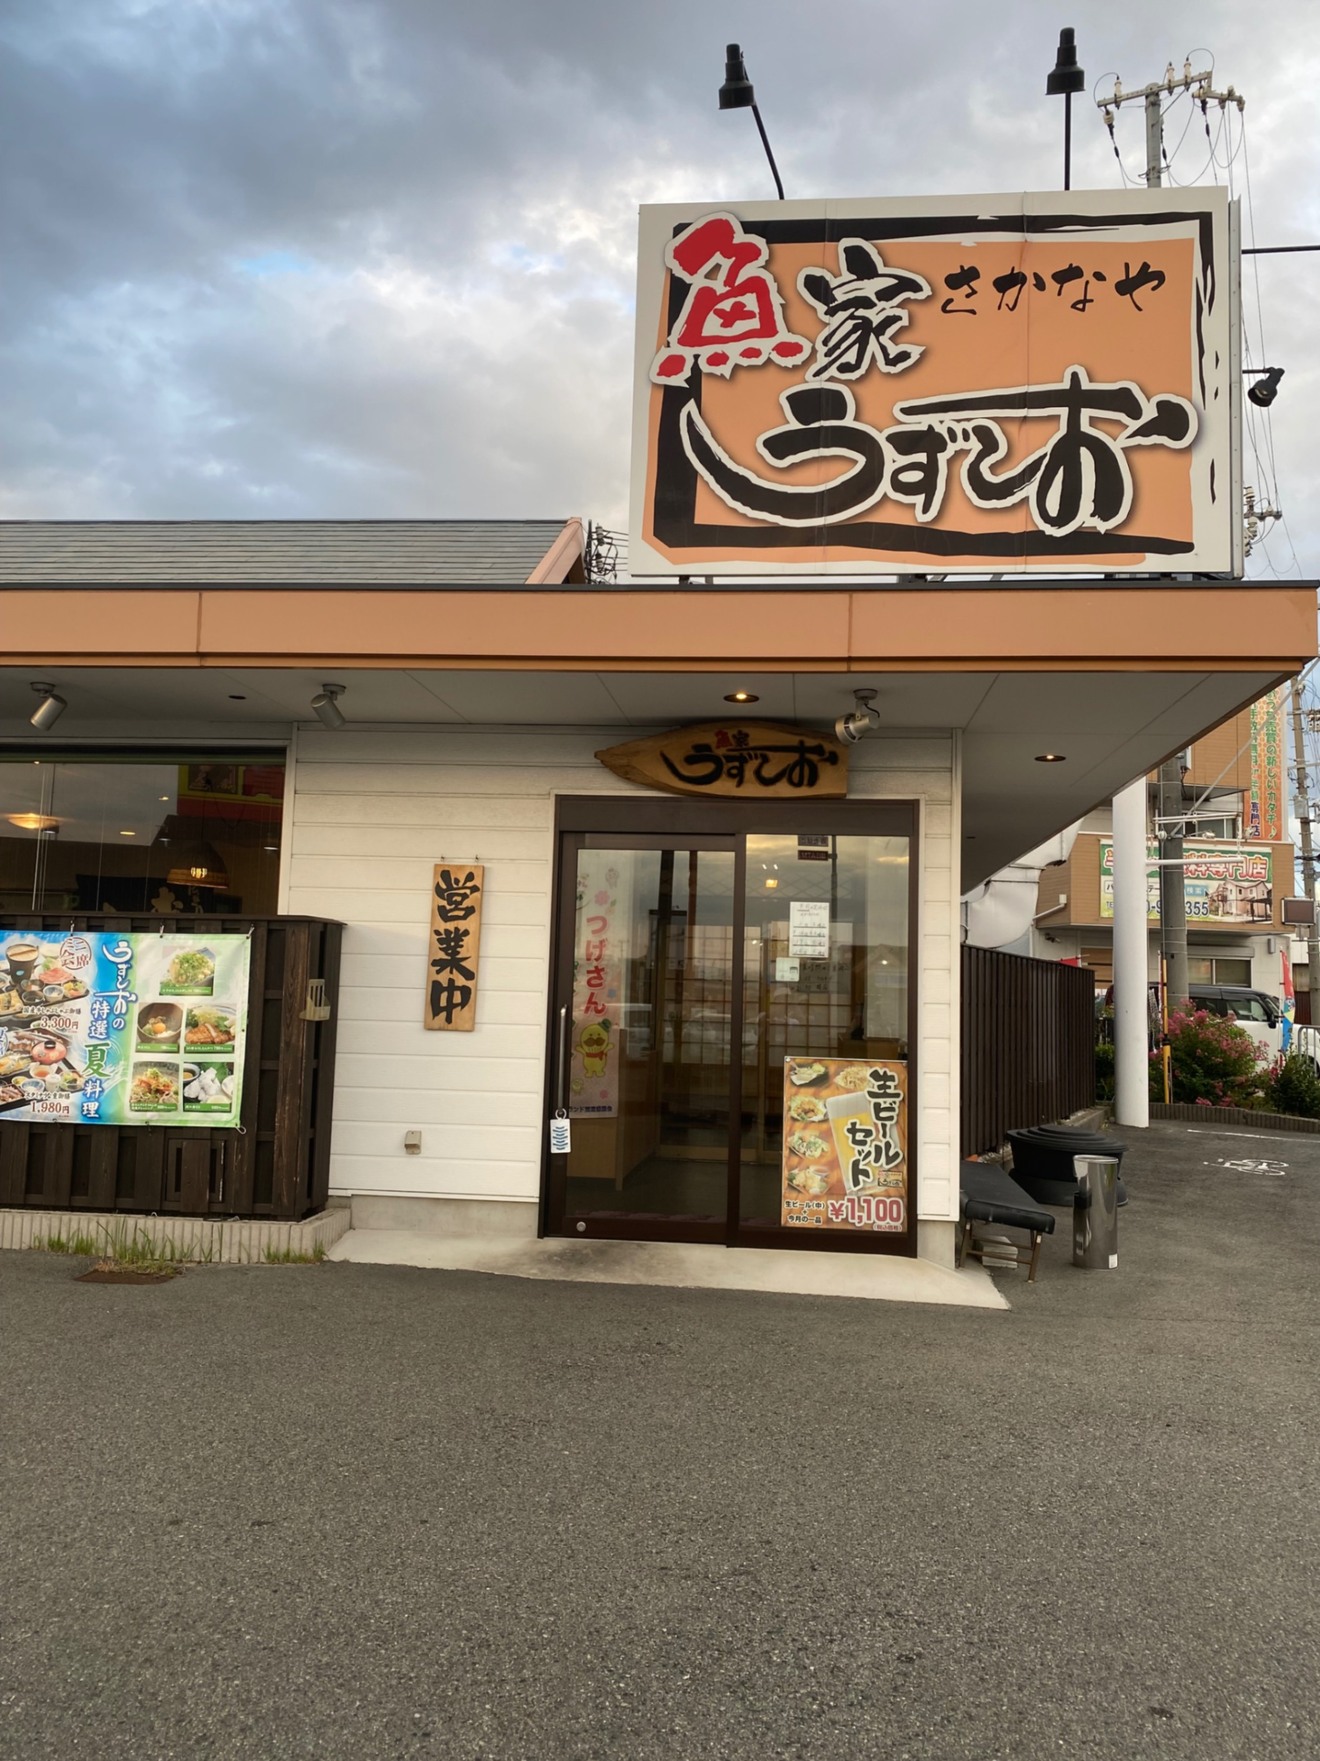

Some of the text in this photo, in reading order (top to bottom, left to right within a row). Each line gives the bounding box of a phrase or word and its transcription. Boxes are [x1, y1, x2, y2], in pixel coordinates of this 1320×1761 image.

[939, 261, 1167, 316] さかなや
[682, 366, 1195, 535] うずしお
[660, 740, 839, 788] うずしお
[430, 869, 481, 1025] 営業中
[583, 914, 609, 1016] つげさん
[41, 1017, 79, 1030] 3,300円
[32, 1102, 70, 1114] 1,980円
[867, 1069, 902, 1168] 生ビール
[846, 1121, 873, 1188] セット
[788, 1215, 822, 1224] 今月の一品
[829, 1198, 900, 1226] ¥1,100
